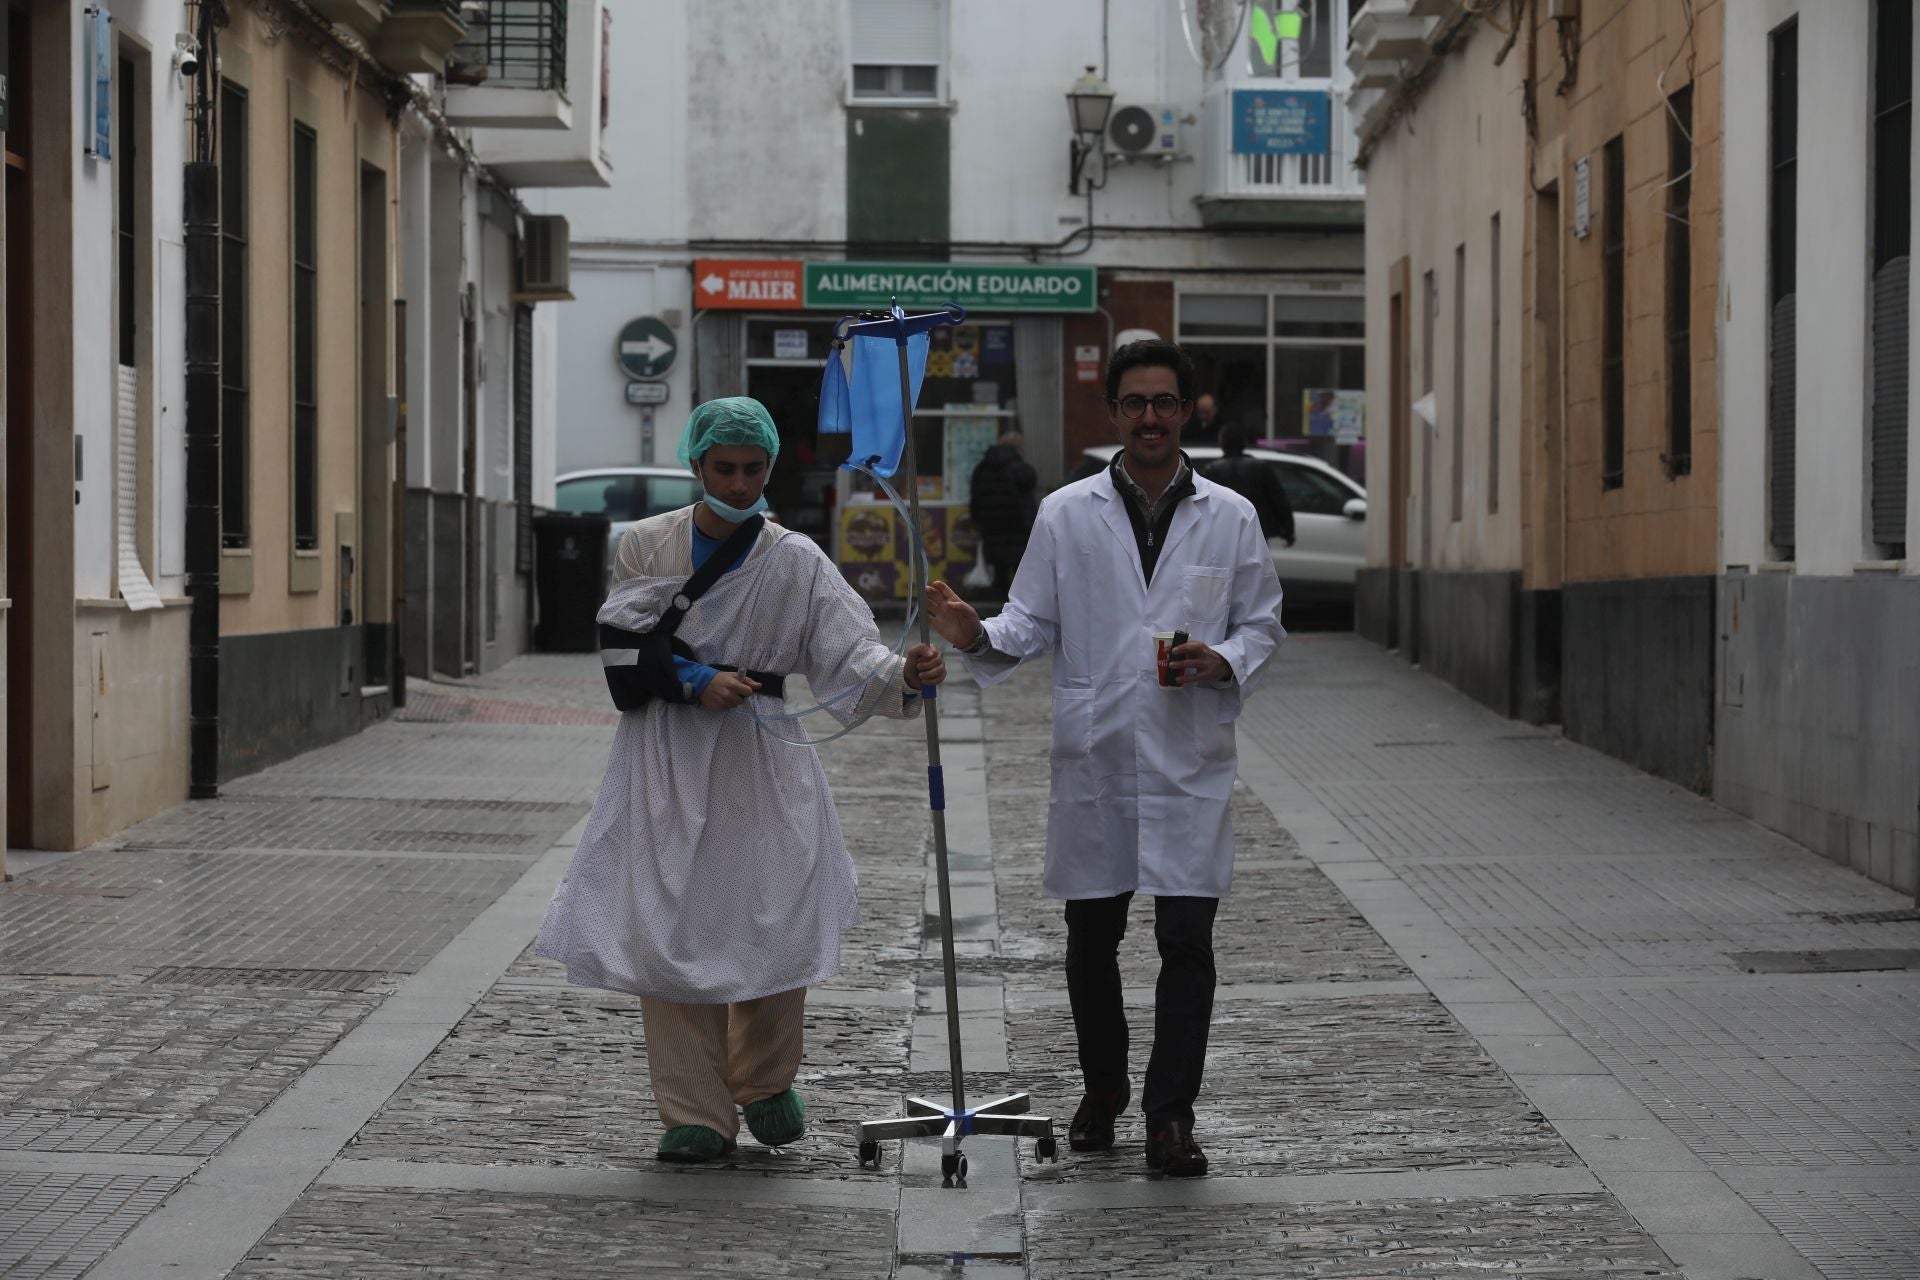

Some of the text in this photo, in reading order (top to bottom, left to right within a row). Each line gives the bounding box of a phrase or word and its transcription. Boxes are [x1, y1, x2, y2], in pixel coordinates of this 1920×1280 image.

[728, 280, 796, 300] MAIER
[817, 270, 1081, 294] ALIMENTACIÓN EDUARDO
